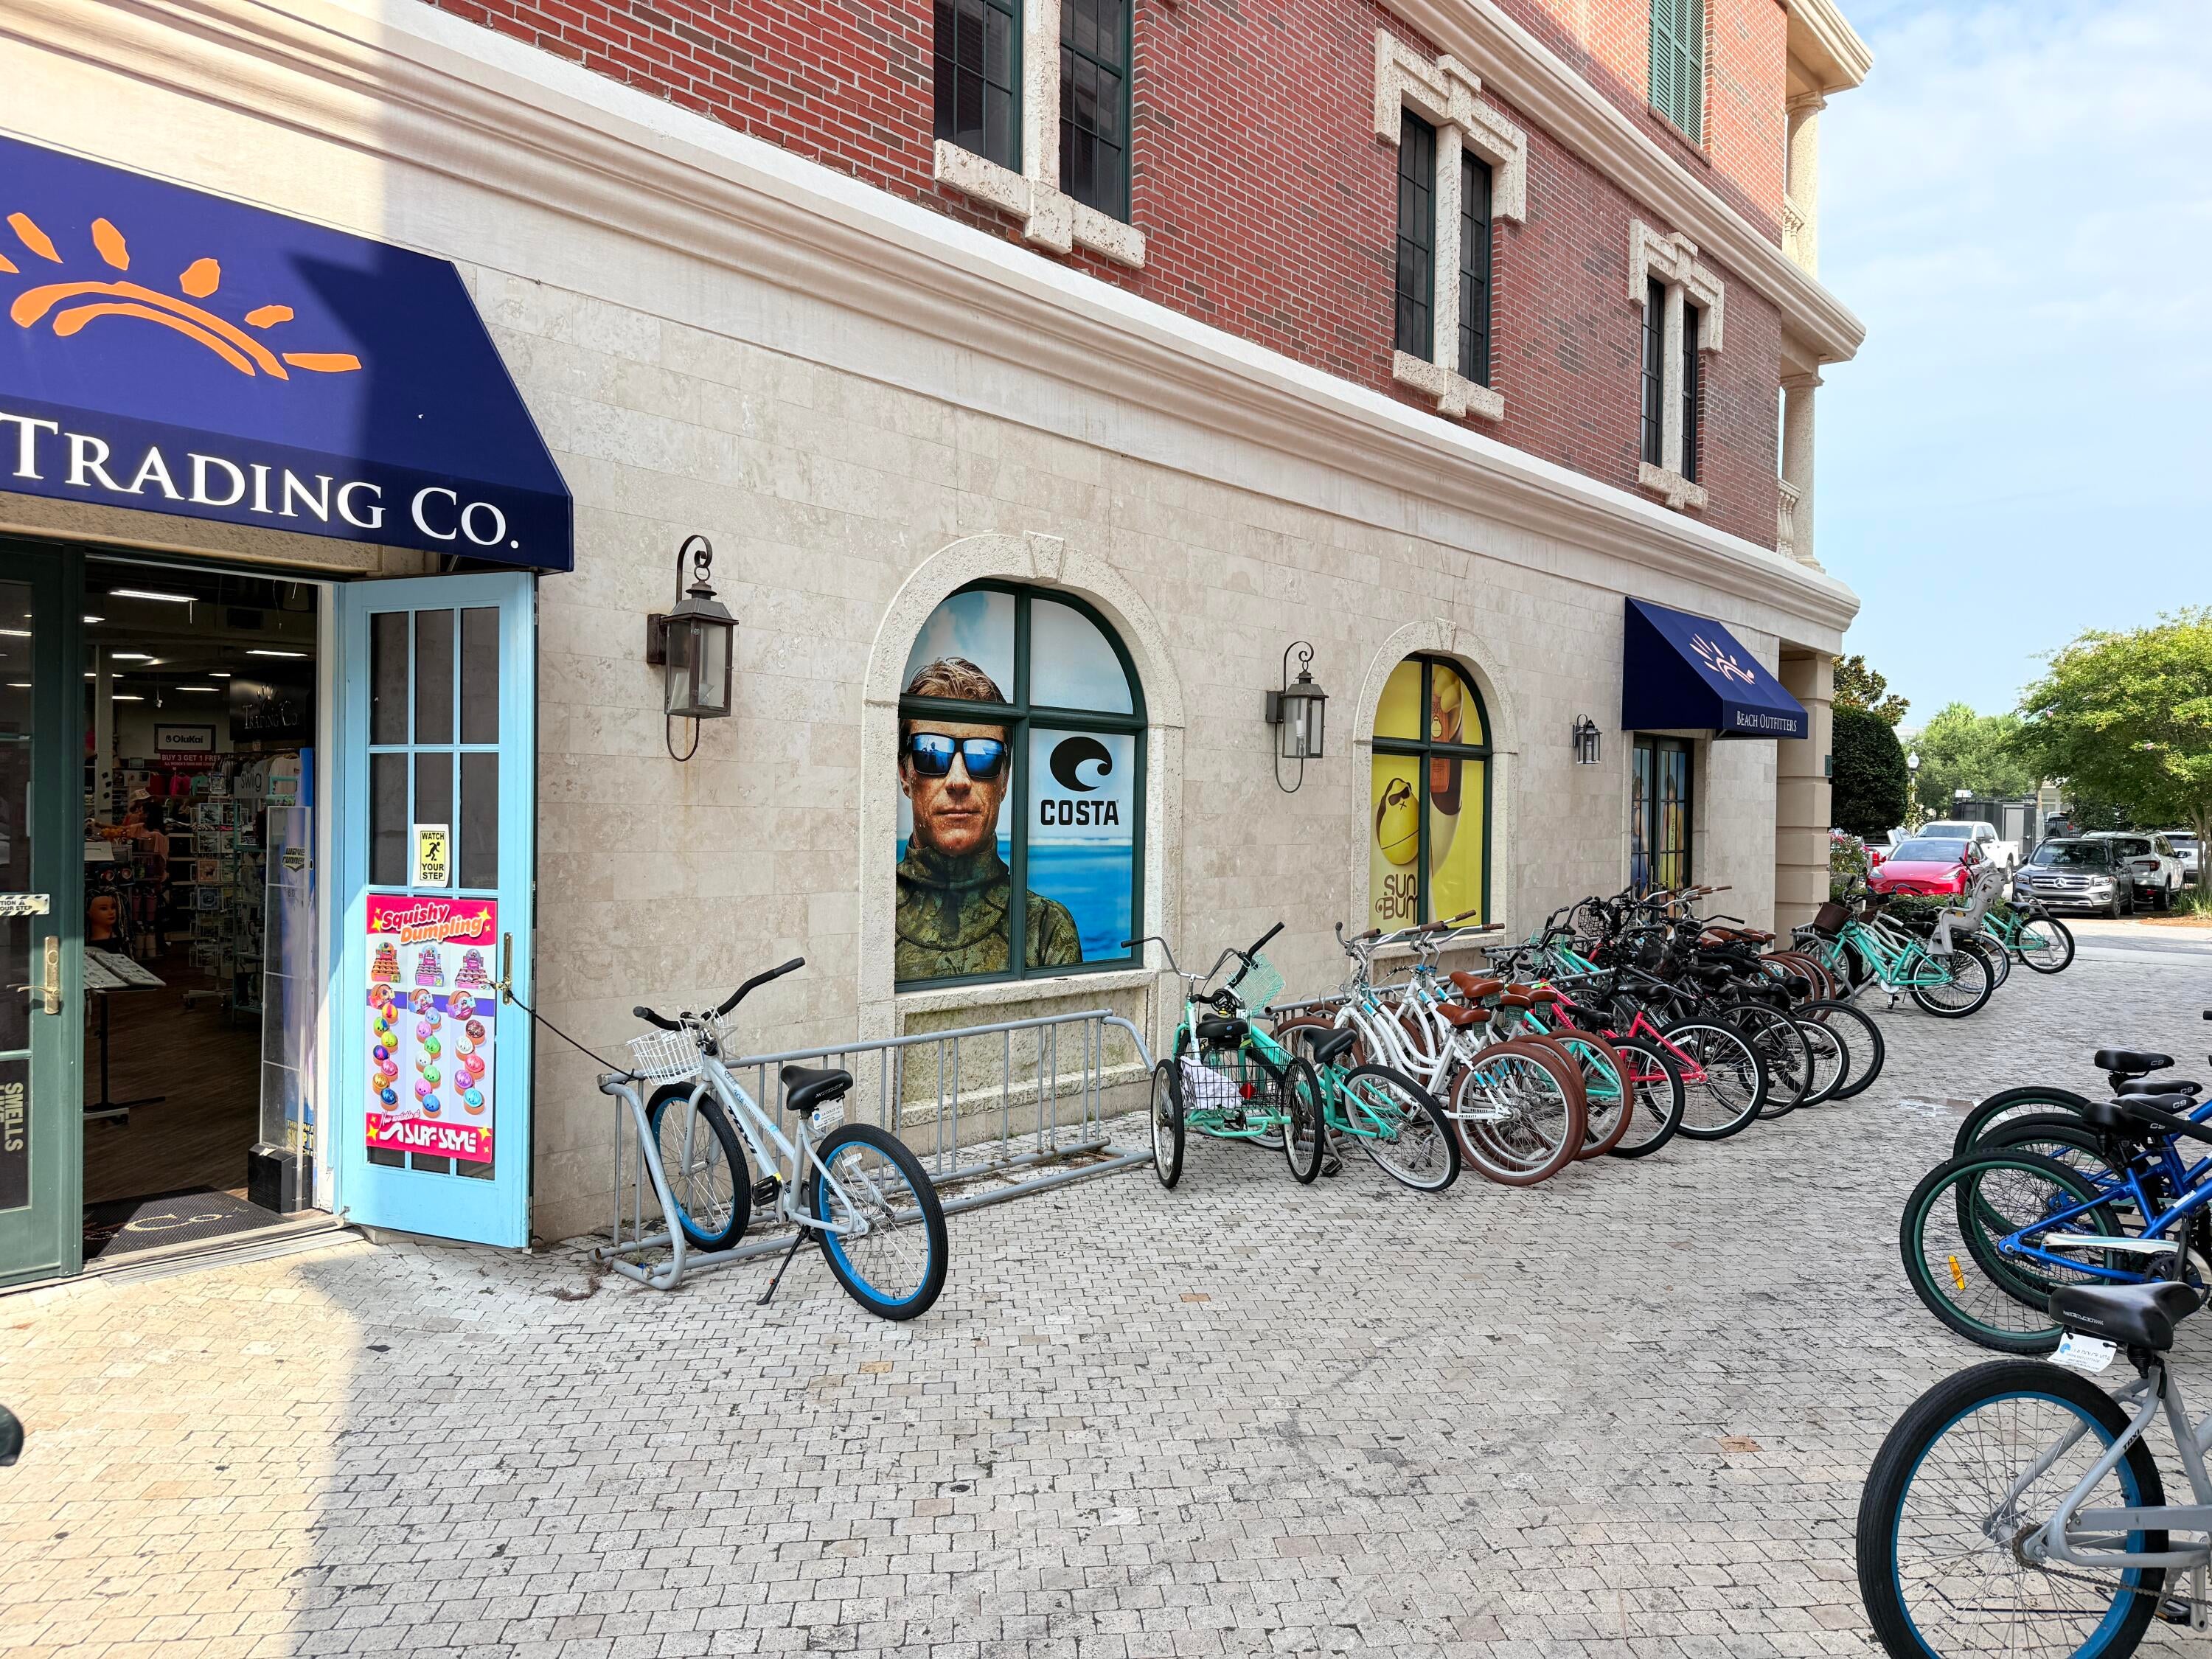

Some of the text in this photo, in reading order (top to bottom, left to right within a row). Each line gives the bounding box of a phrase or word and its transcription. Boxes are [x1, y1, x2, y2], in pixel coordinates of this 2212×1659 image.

[1736, 710, 1798, 732] BEACH OUTFITTERS
[173, 734, 204, 744] OluKai
[1040, 799, 1119, 826] COSTA
[421, 832, 445, 840] WATCH
[422, 863, 445, 872] YOUR
[422, 872, 443, 880] STEP
[1384, 874, 1416, 898] SUN
[381, 901, 450, 931] Squishy
[400, 914, 485, 945] Dumpling
[2172, 1099, 2187, 1109] C9
[4, 1082, 24, 1152] SMELLS
